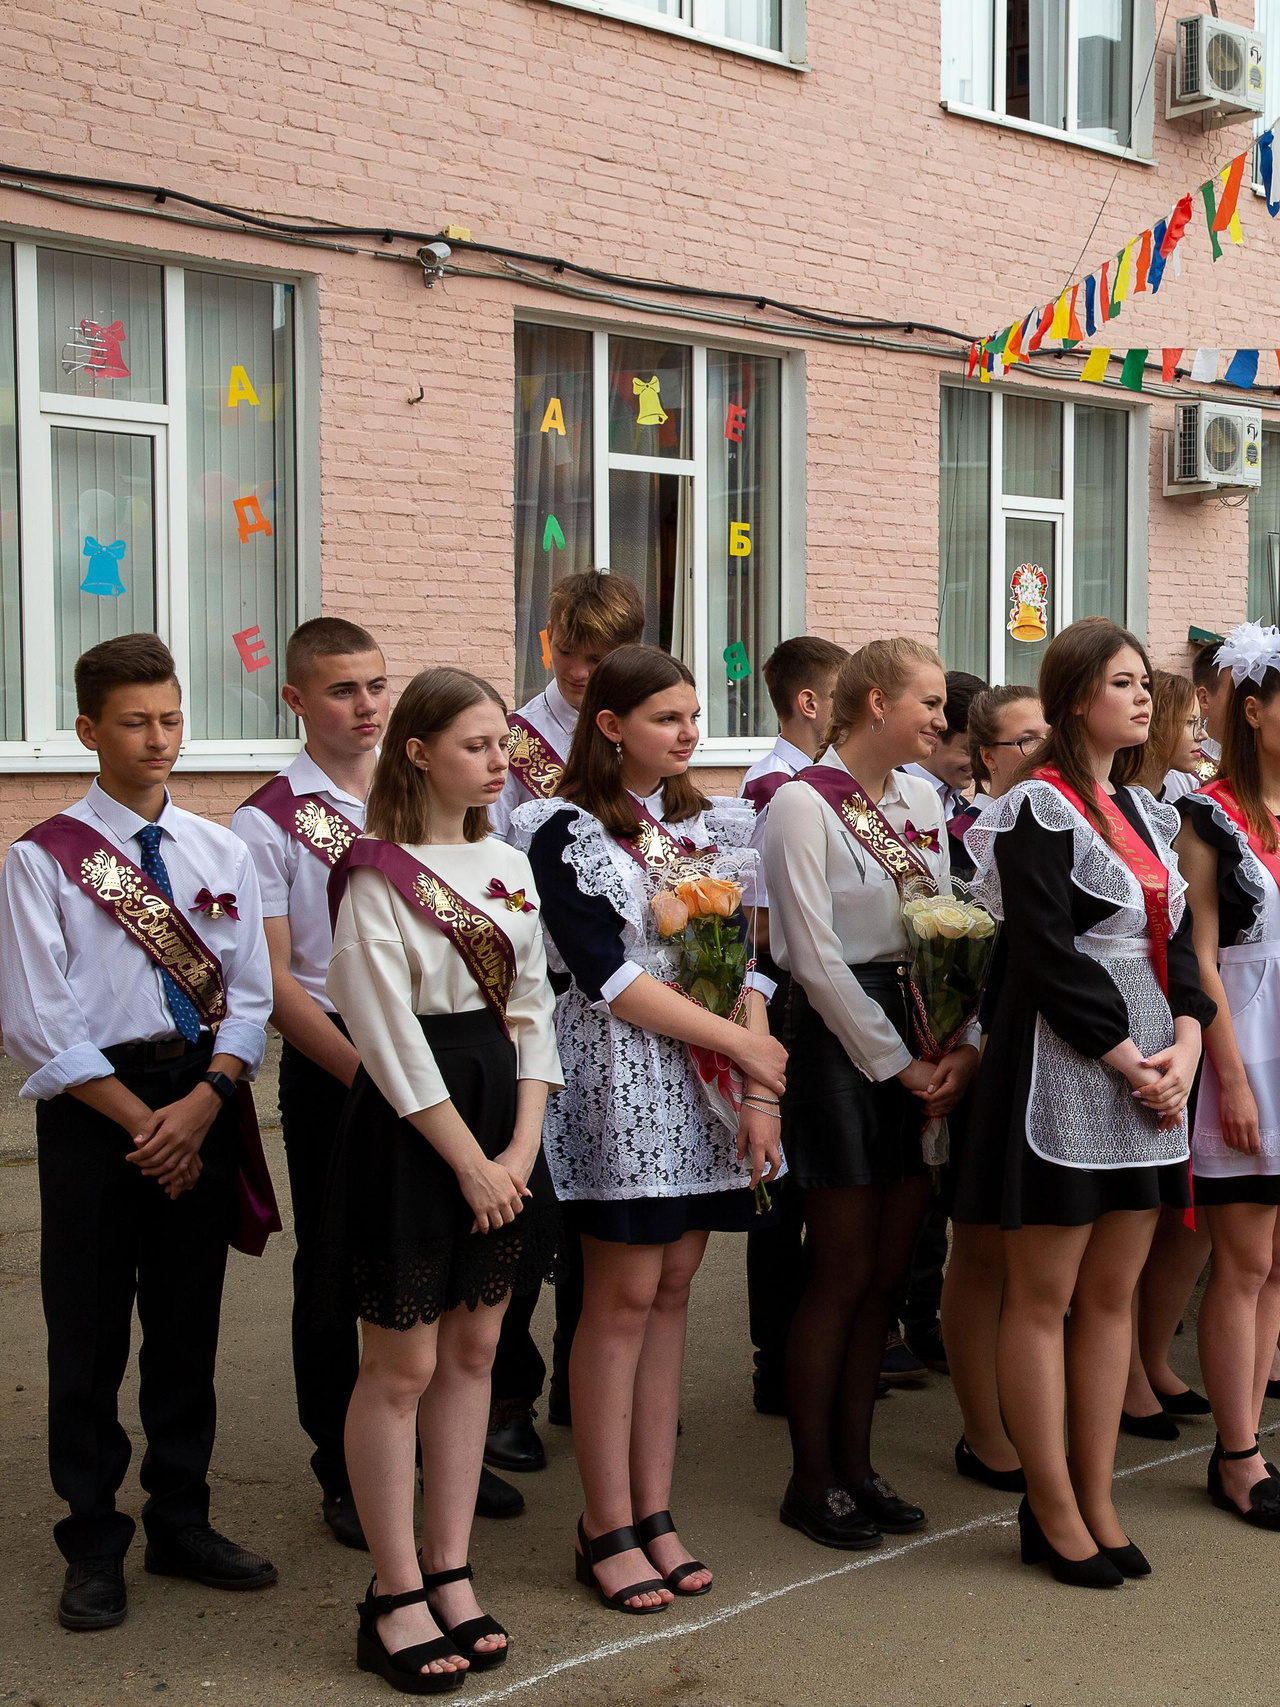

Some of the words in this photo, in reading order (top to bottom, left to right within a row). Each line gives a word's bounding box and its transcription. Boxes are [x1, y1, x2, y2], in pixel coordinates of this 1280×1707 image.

[227, 365, 260, 407] А
[539, 397, 567, 436] А
[724, 403, 747, 444] Е
[232, 495, 273, 544] Д
[729, 521, 751, 557] Б
[232, 624, 271, 674] Е
